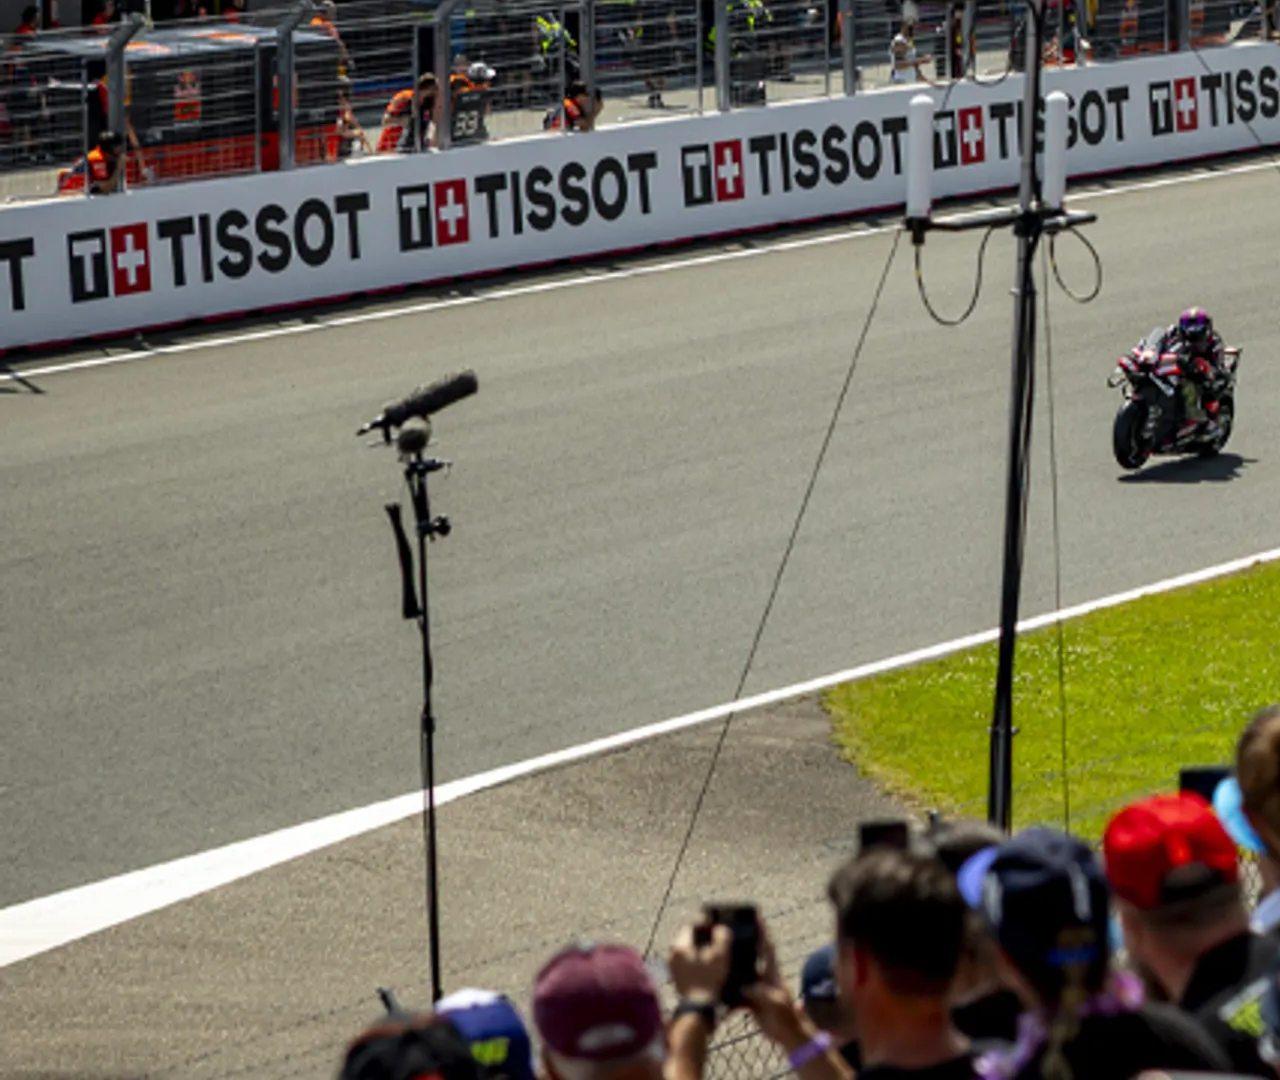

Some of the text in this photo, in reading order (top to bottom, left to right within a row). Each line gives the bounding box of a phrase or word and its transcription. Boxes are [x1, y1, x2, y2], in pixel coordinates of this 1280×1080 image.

[474, 151, 659, 238] TISSOT
[747, 116, 909, 196] TISSOT
[156, 191, 371, 288] TISSOT
